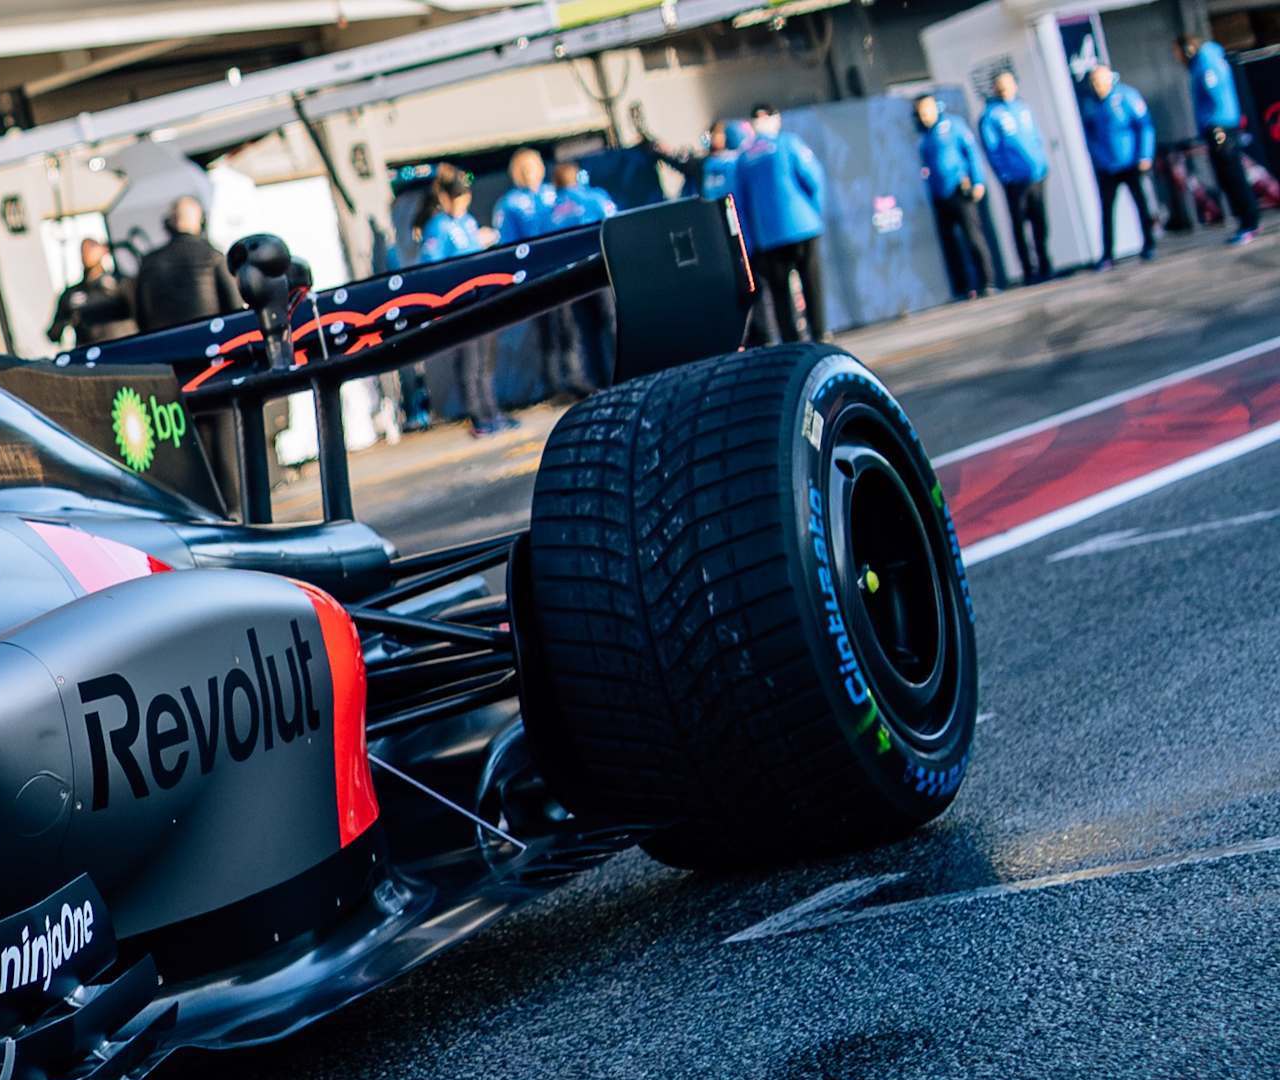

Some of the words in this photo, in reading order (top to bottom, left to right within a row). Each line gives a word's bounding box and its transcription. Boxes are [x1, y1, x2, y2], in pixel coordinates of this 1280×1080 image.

[149, 394, 186, 449] bp
[78, 618, 321, 812] Revolut
[0, 899, 93, 995] ninjaOne
